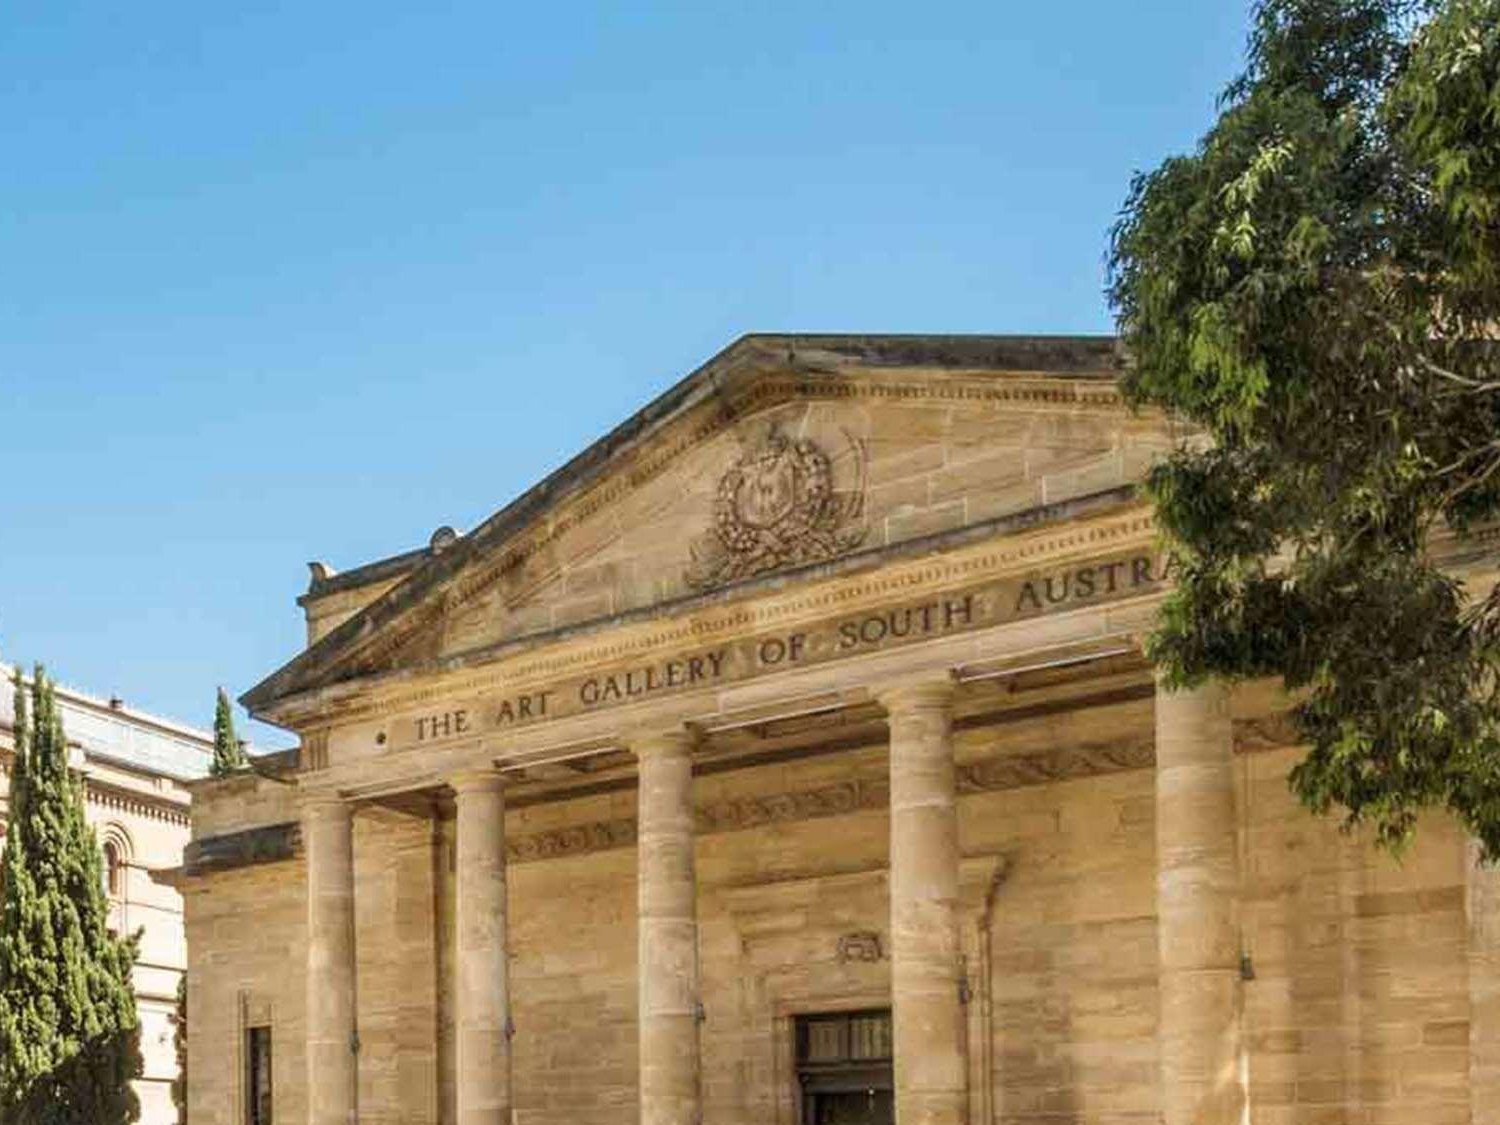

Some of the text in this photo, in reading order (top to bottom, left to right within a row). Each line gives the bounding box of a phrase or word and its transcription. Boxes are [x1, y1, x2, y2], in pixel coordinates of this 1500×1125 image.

[414, 710, 468, 740] THE
[496, 691, 553, 725] ART
[580, 651, 724, 704] GALLERY
[760, 633, 805, 664] OF
[838, 596, 973, 649] SOUTH
